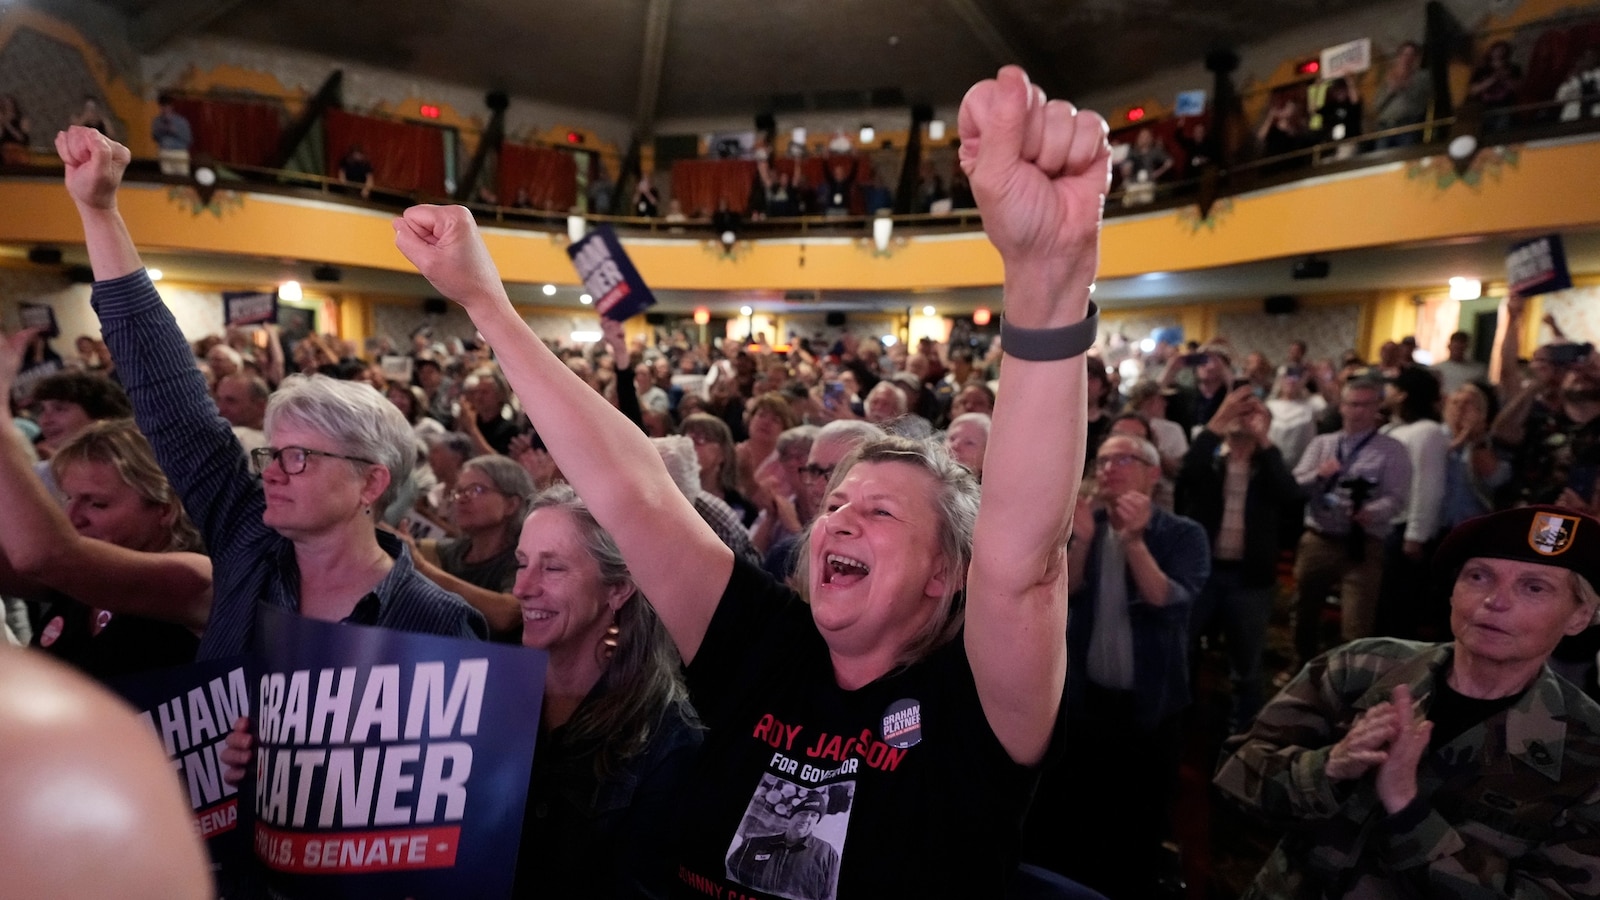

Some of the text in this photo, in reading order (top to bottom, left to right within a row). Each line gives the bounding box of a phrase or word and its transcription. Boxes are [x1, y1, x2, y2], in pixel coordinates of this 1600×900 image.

[139, 667, 249, 755] HAM
[258, 658, 489, 746] GRAHAM
[770, 752, 799, 776] FOR
[807, 728, 908, 771] JACSON
[256, 741, 474, 829] PLATNER
[268, 836, 296, 867] U.S.
[303, 834, 429, 867] SENATE
